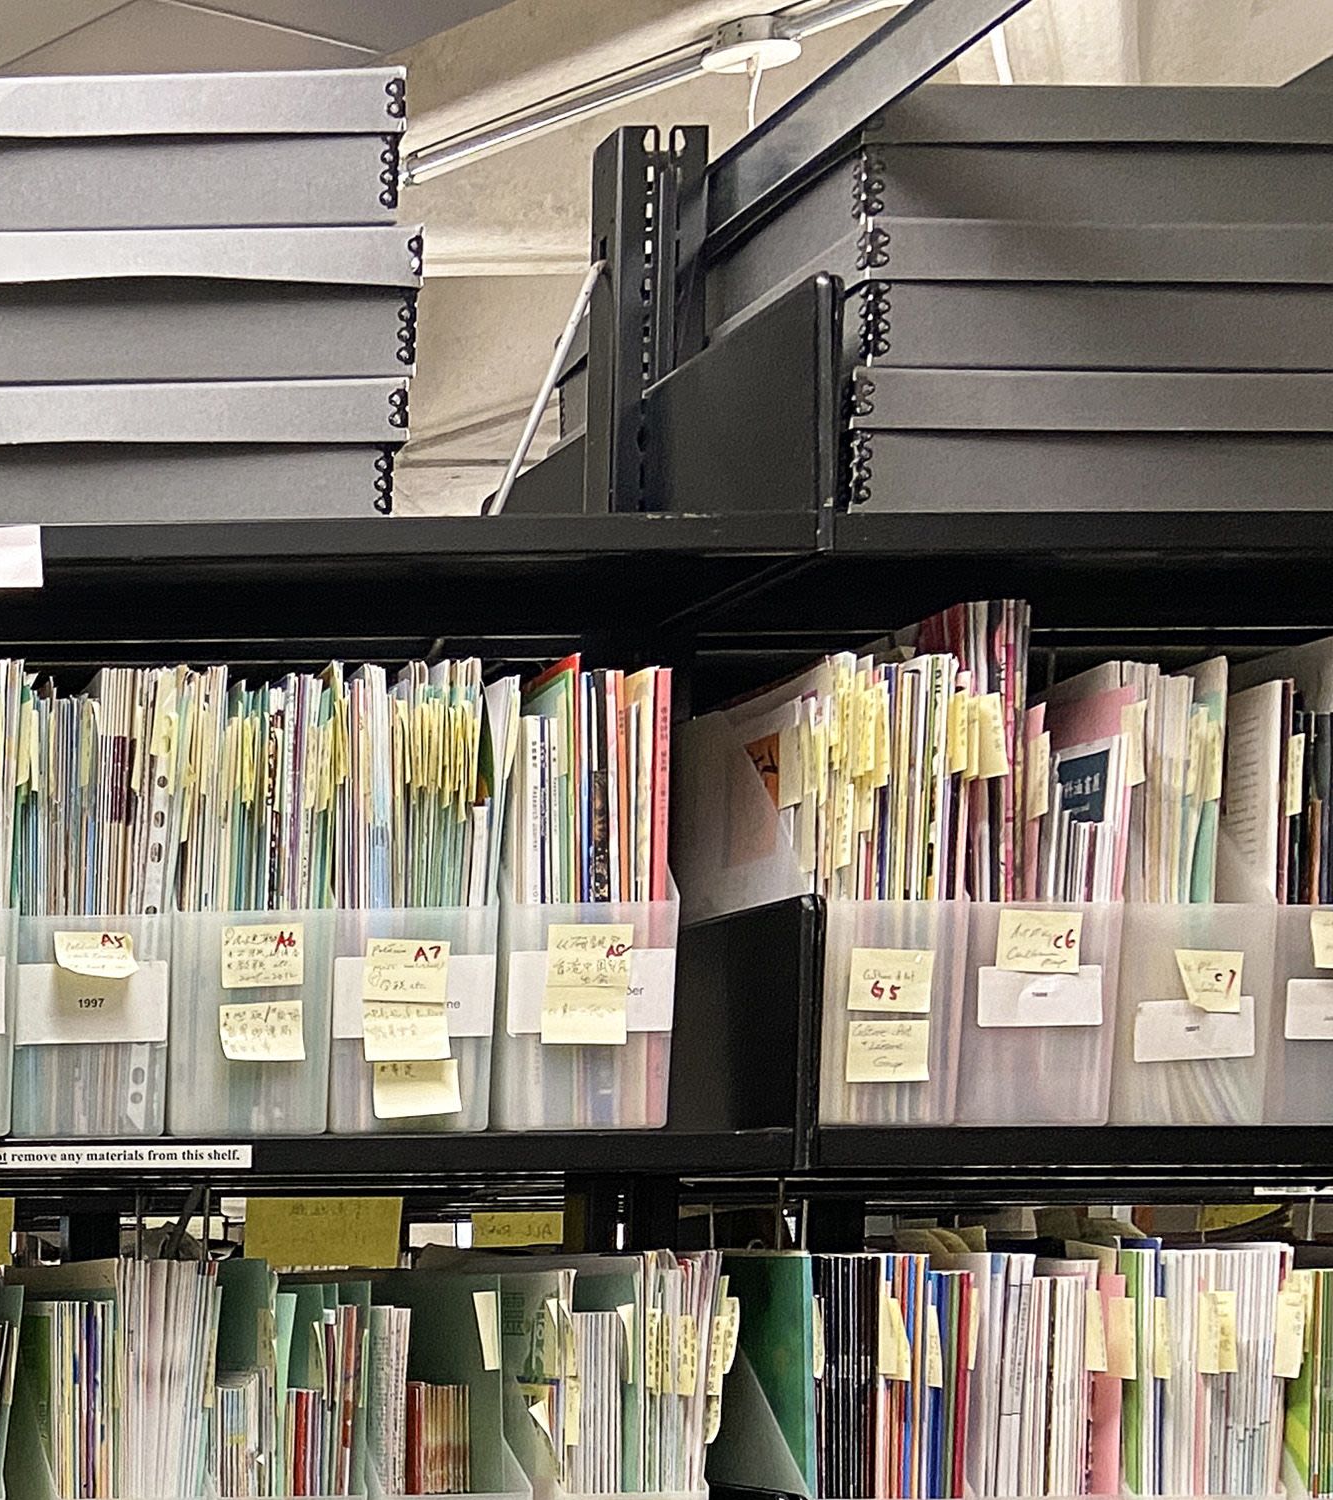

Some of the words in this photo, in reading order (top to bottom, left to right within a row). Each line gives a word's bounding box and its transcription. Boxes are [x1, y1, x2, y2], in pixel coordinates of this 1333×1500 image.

[101, 933, 125, 948] A5
[275, 931, 296, 952] A6
[1053, 929, 1076, 949] C6
[414, 946, 441, 962] A7
[77, 998, 105, 1008] 1997
[11, 1152, 58, 1163] remove
[60, 1152, 83, 1165] any
[86, 1149, 145, 1162] materials
[147, 1149, 178, 1161] from
[181, 1149, 205, 1162] this
[207, 1149, 241, 1162] shelf.
